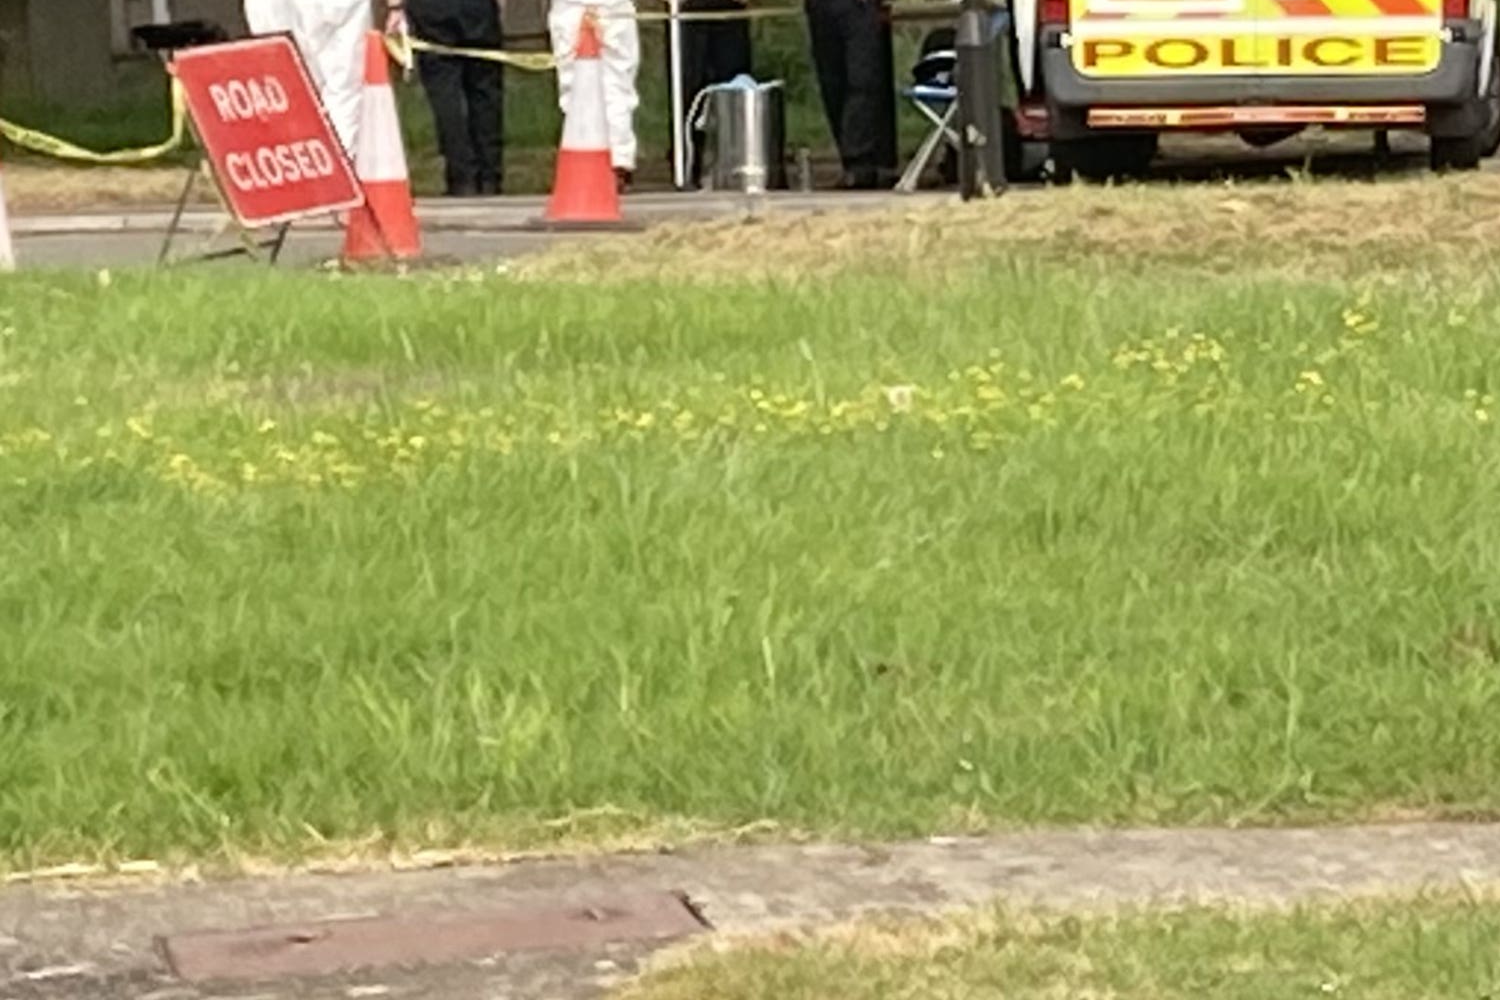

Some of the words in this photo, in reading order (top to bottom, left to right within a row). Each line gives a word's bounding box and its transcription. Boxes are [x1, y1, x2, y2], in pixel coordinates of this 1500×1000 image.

[1083, 36, 1427, 69] POLICE
[208, 75, 289, 122] ROAD
[226, 139, 333, 191] CLOSED
